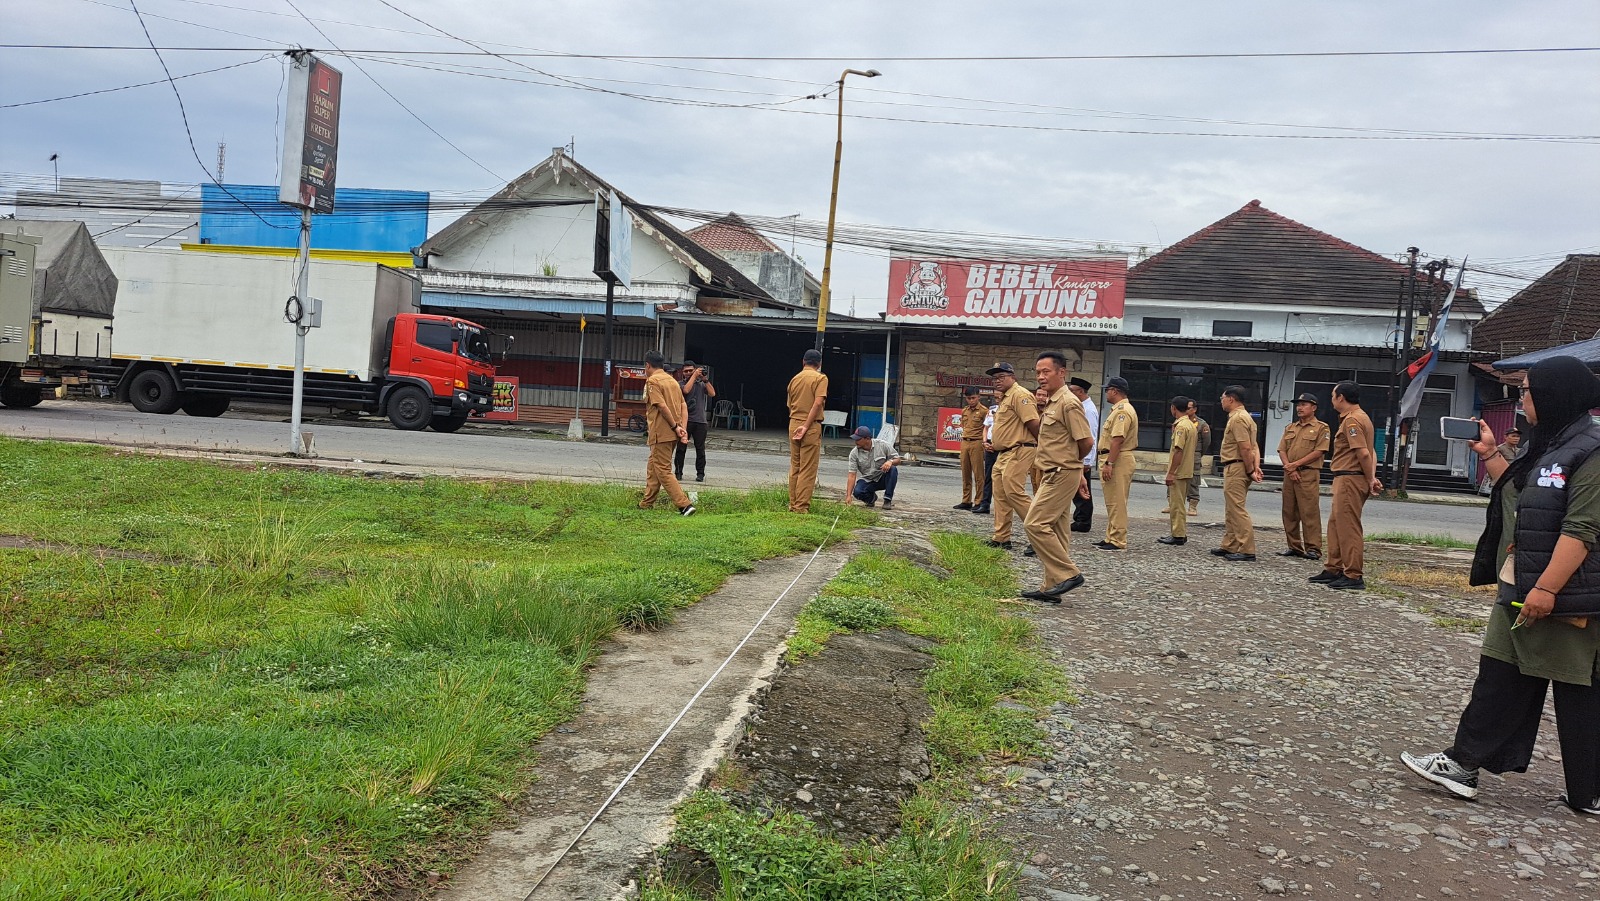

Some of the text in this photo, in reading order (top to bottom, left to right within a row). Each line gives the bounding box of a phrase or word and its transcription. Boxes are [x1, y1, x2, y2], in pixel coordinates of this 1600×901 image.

[312, 93, 334, 111] DJARUM
[314, 105, 331, 120] SUPER
[310, 122, 332, 139] KRETEK
[966, 263, 1113, 294] BEBEK Kanigoro
[900, 294, 949, 308] GANTUNG
[964, 288, 1097, 315] GANTUNG
[1099, 322, 1118, 330] 9666
